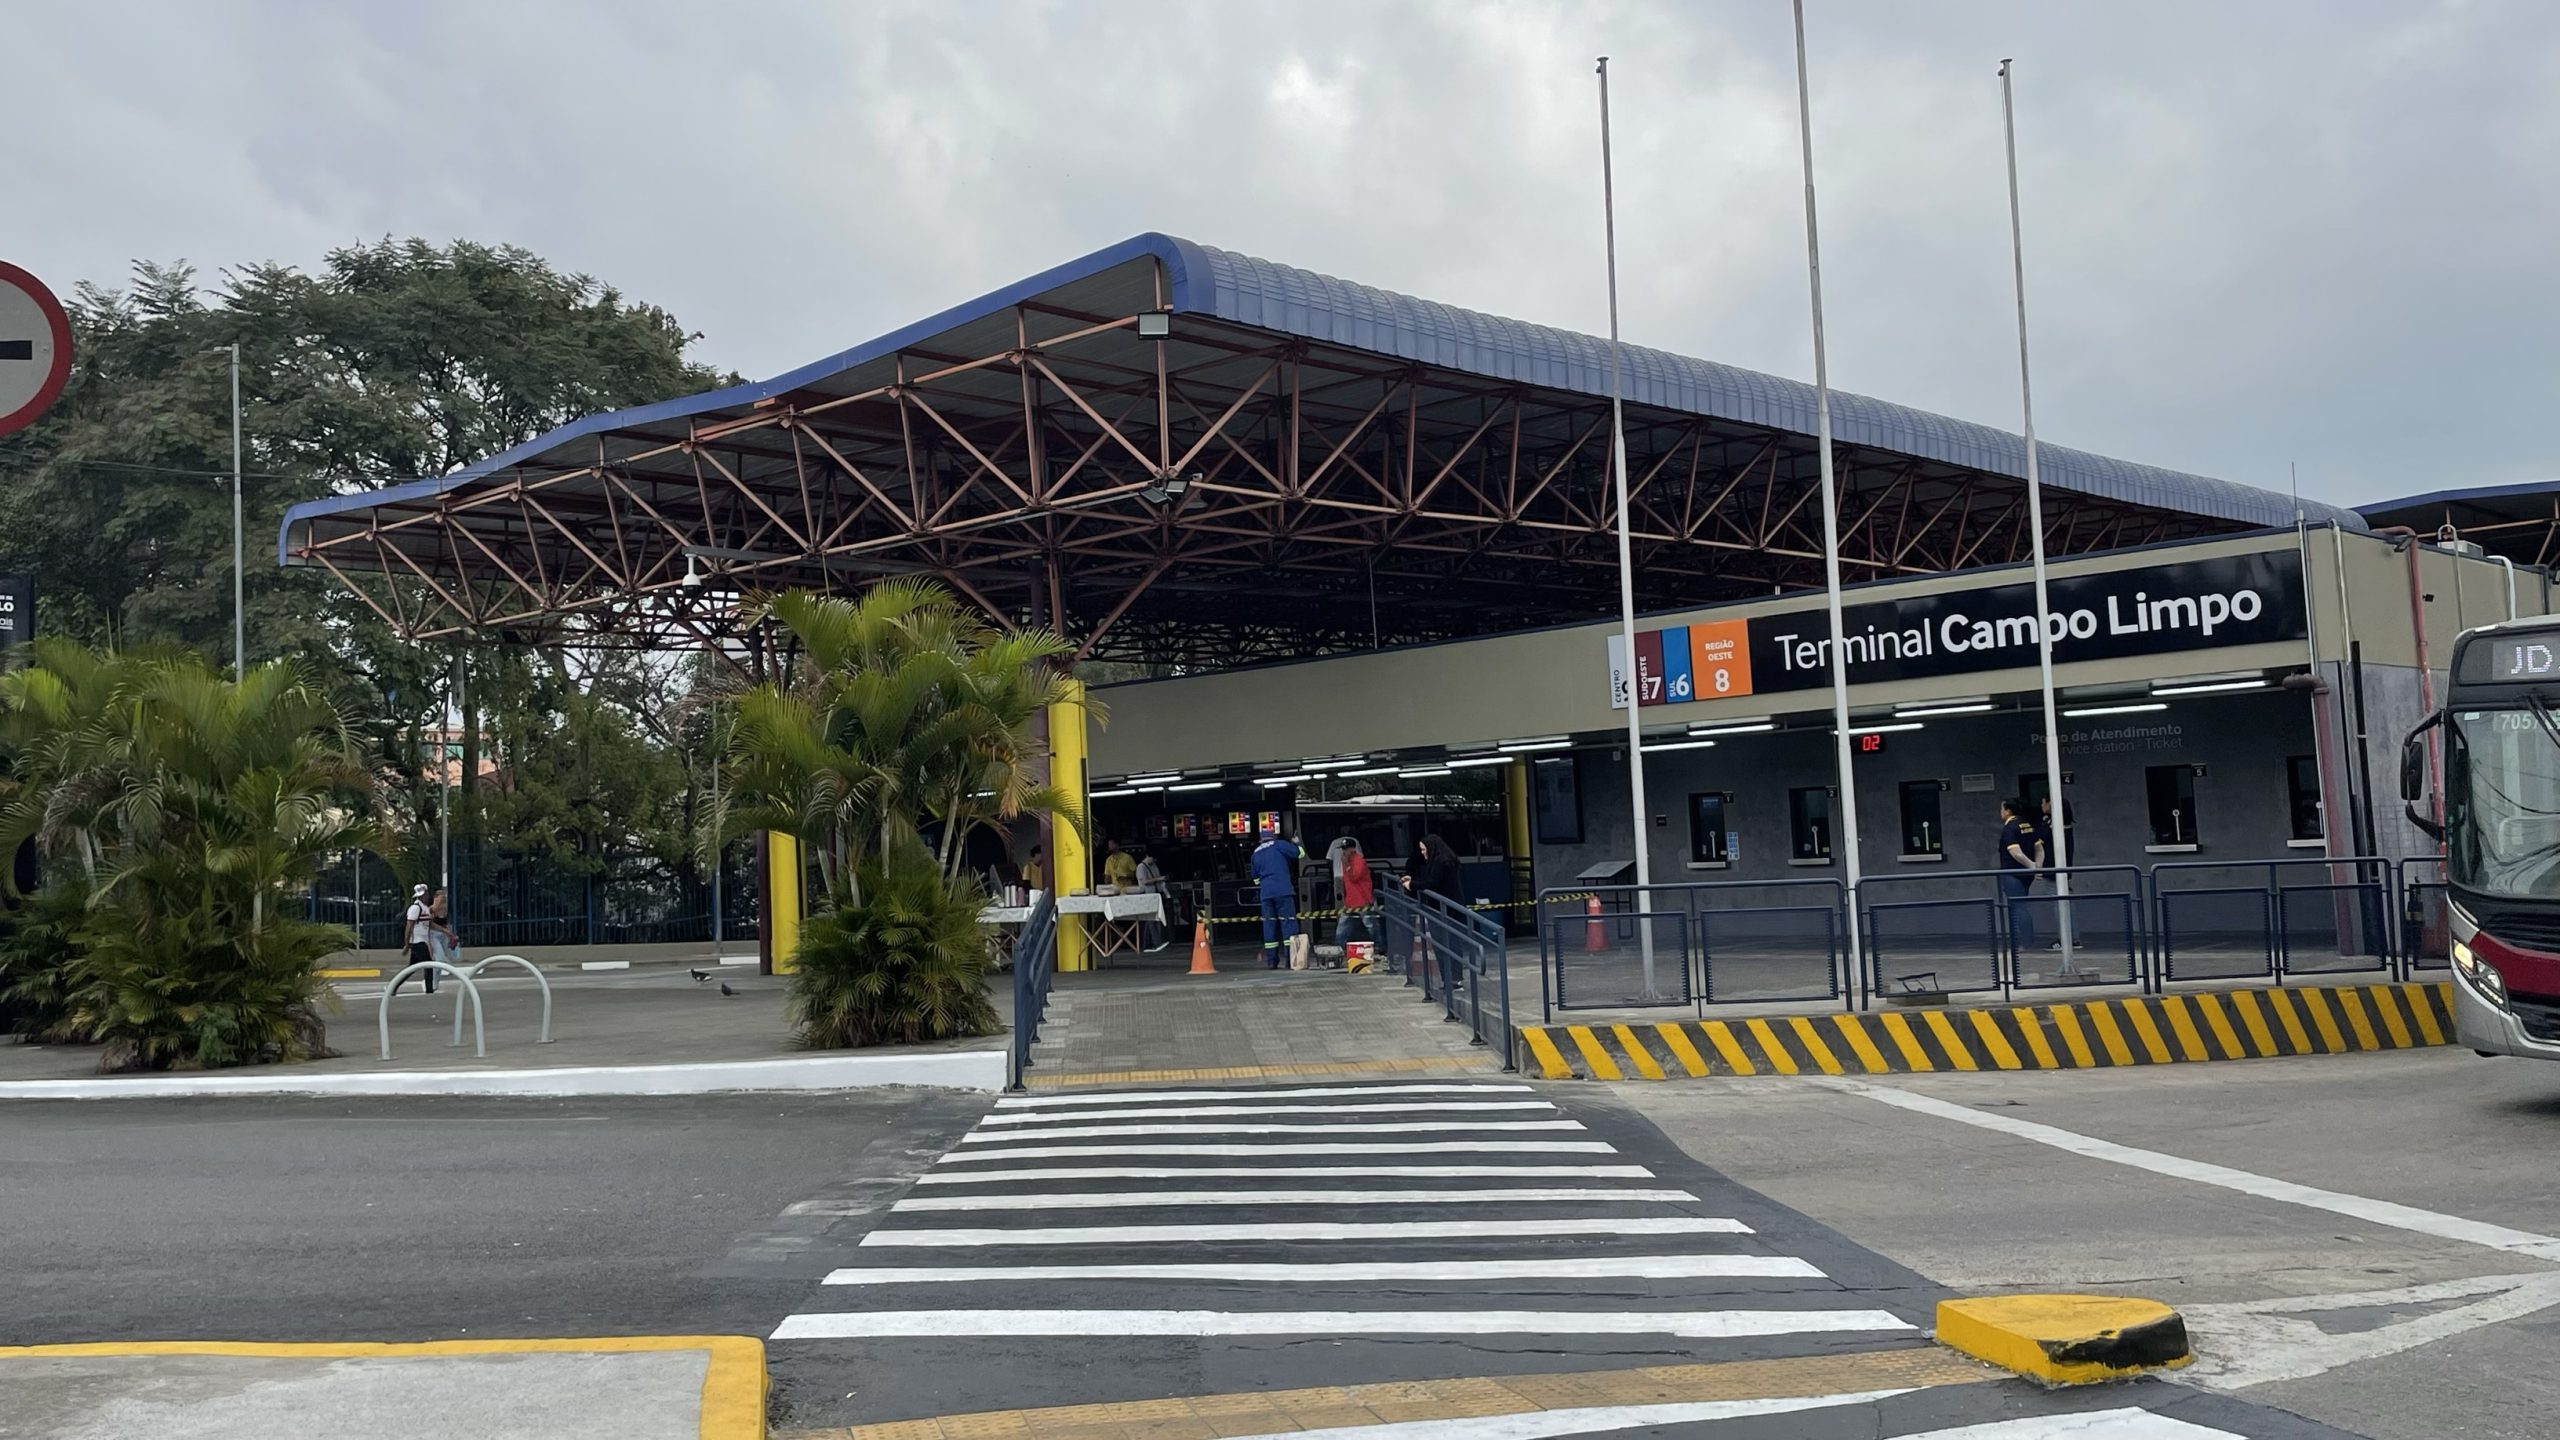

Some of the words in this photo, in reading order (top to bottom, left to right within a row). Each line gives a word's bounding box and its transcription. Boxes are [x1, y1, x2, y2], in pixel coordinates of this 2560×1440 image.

[1774, 618, 1933, 671] Terminal
[1940, 608, 2098, 653] Campo
[2107, 589, 2263, 636] Limpo
[1705, 640, 1734, 651] REGIÃO
[1707, 651, 1733, 662] OESTE
[1613, 669, 1622, 703] CENTRO
[1639, 655, 1649, 701] SUDOESTE
[1647, 676, 1662, 700] 7
[1676, 672, 1690, 697] 6
[1715, 668, 1730, 693] 8
[1669, 680, 1677, 698] SUL
[1862, 734, 1880, 751] 02
[2071, 730, 2089, 742] de
[2091, 724, 2182, 741] Atendimento
[2093, 740, 2136, 754] station
[2144, 736, 2183, 750] Ticket
